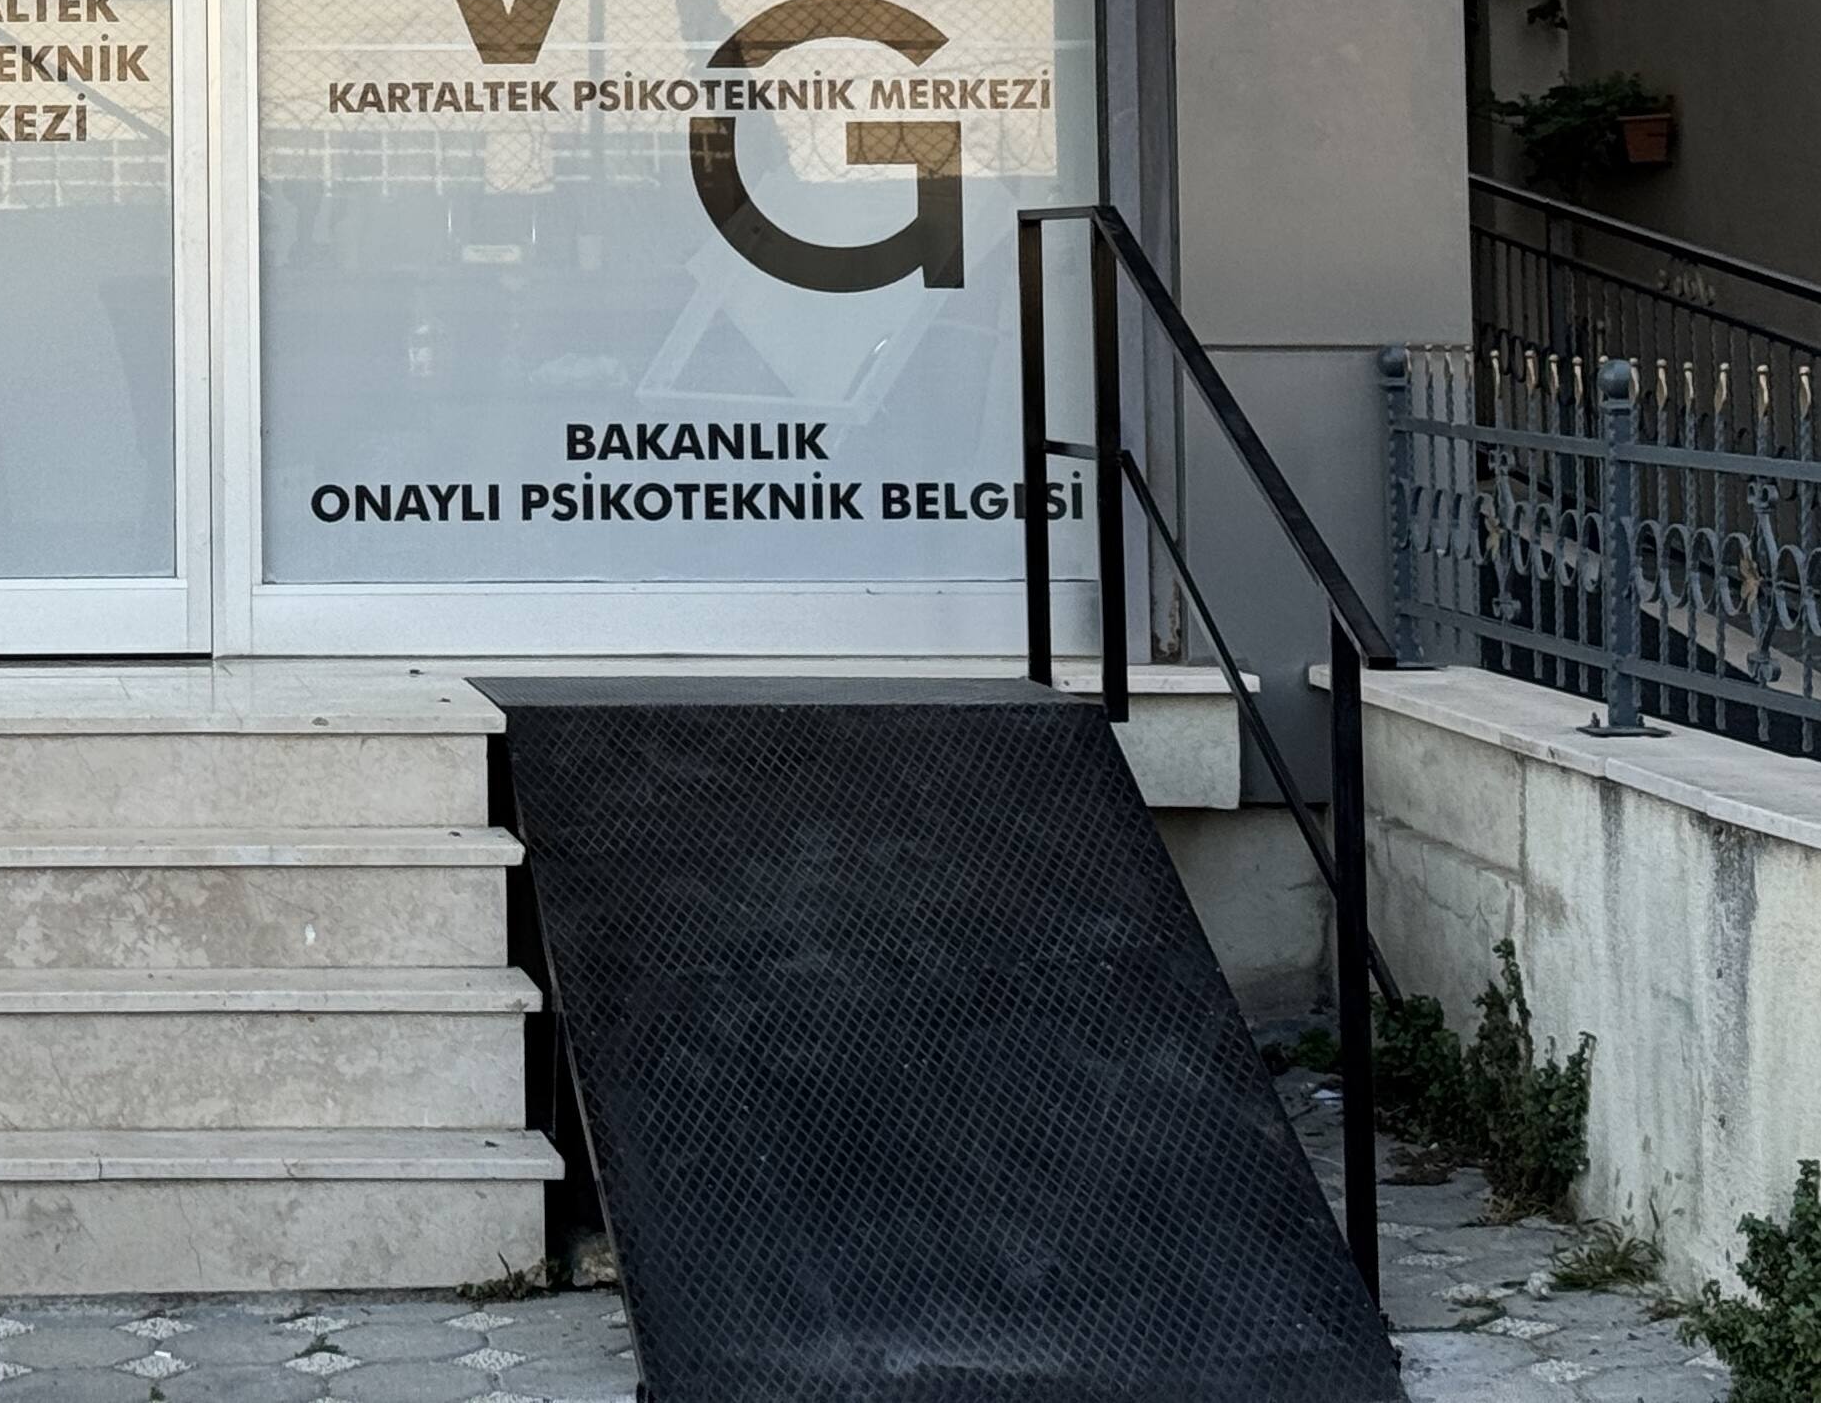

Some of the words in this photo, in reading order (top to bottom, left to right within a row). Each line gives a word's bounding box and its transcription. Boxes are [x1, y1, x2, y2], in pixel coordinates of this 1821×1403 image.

[329, 81, 559, 114] KARTALTEK
[574, 71, 855, 112] PSİKOTEKNİK
[869, 69, 1052, 110] MERKEZİ
[566, 423, 830, 461] BAKANLIK
[311, 484, 500, 523] ONAYLI
[521, 471, 865, 522] PSİKOTEKNİK
